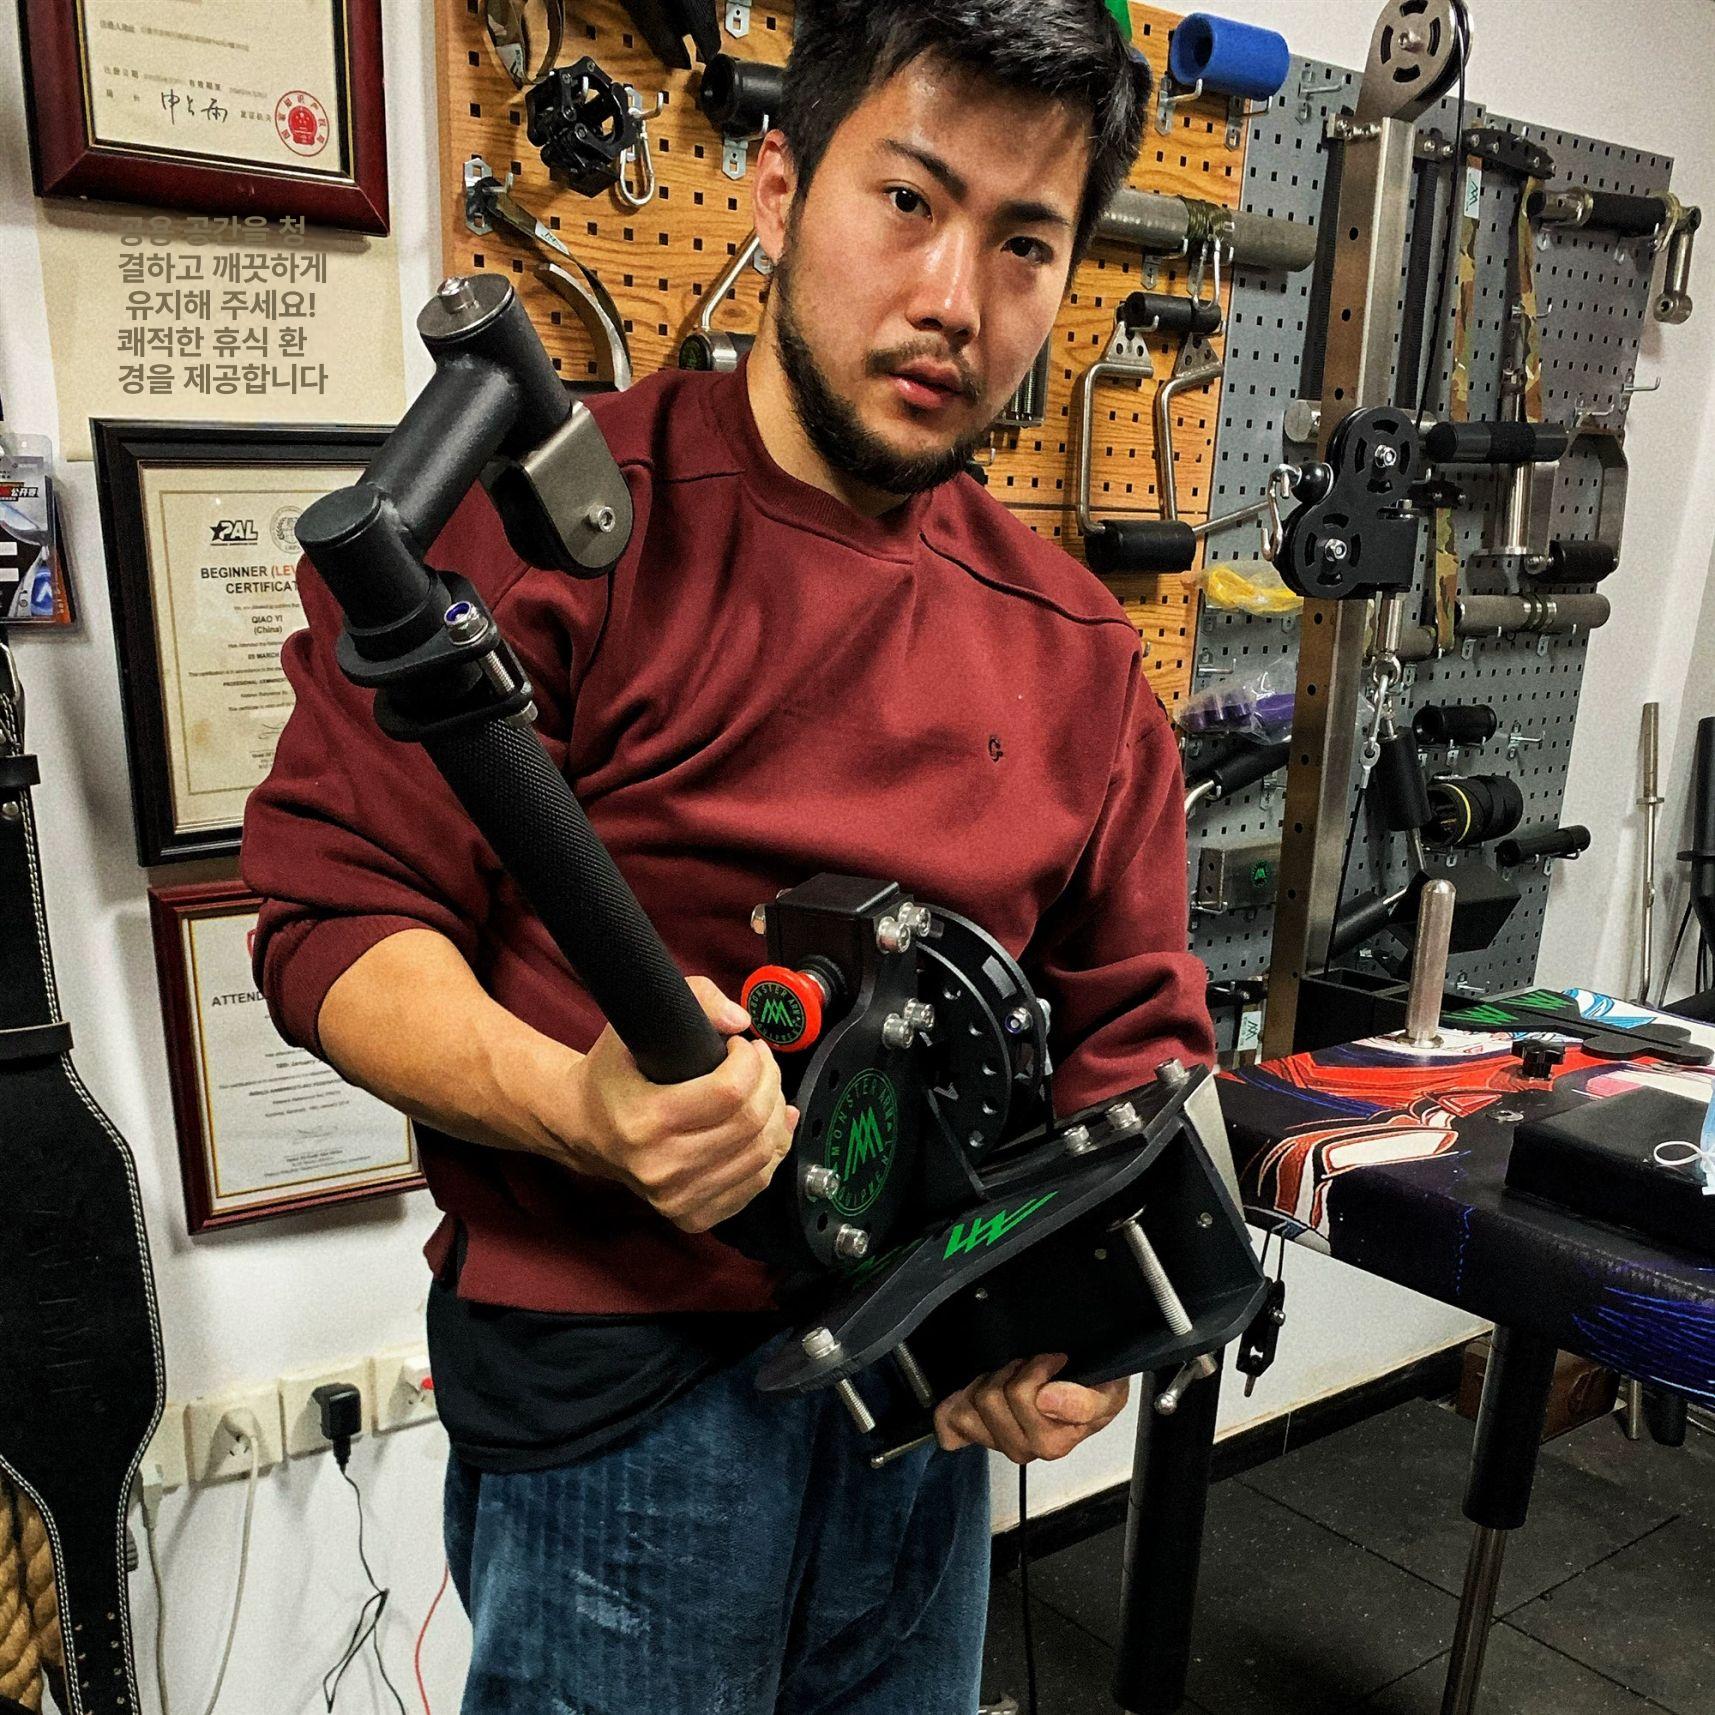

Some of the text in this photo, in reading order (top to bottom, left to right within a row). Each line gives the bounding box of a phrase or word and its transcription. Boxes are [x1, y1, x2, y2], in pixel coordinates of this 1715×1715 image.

[216, 519, 259, 541] PAL
[200, 565, 268, 579] BEGINNER
[251, 614, 283, 625] QIAO YI
[253, 625, 283, 636] (China)
